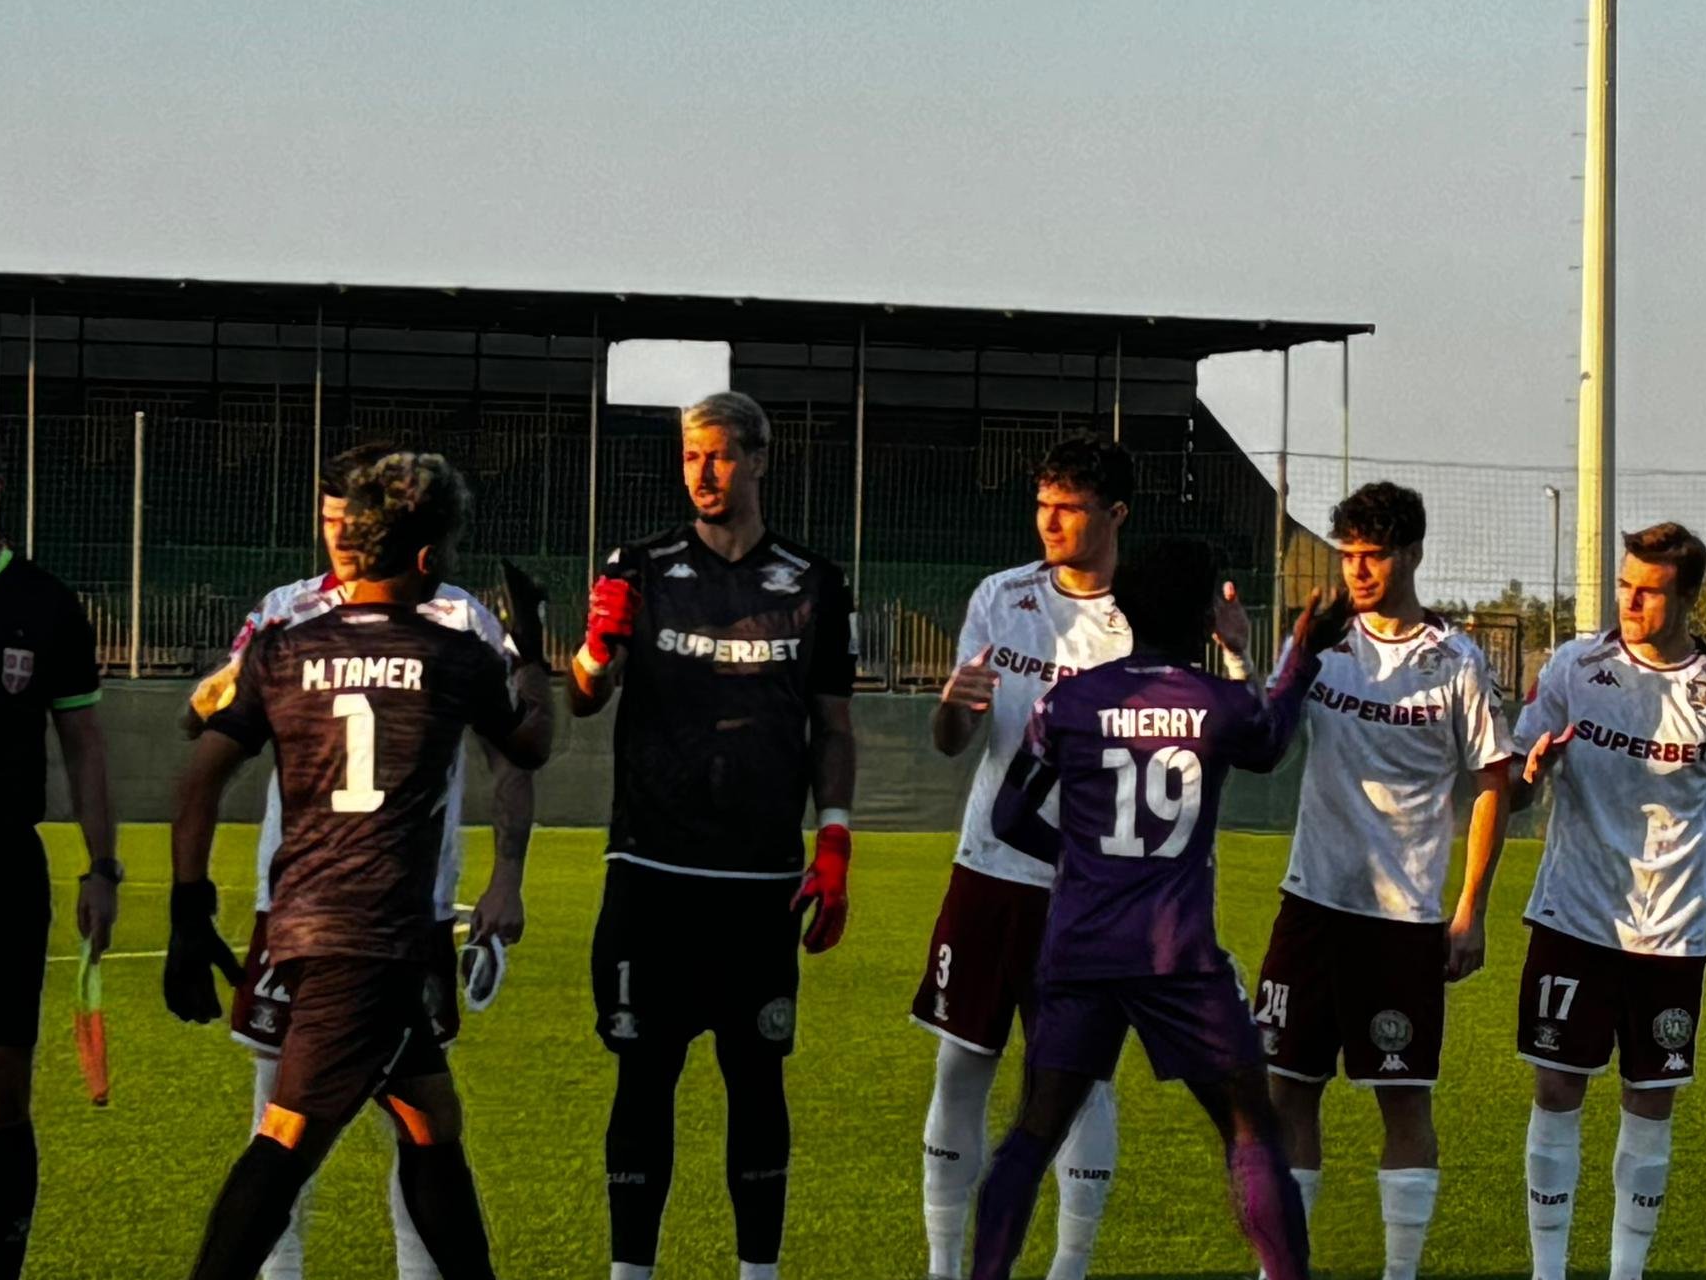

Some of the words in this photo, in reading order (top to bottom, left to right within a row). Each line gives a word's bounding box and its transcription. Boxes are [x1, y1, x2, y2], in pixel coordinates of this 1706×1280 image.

[657, 628, 801, 663] SUPERBET
[302, 656, 424, 691] M.TAMER
[1098, 708, 1208, 738] THIERRY
[1309, 681, 1443, 726] SUPERBET
[331, 693, 385, 812] 1
[1099, 746, 1203, 858] 19
[616, 960, 630, 1005] 1
[936, 943, 952, 989] 3
[1255, 979, 1289, 1028] 24
[1538, 974, 1580, 1020] 17
